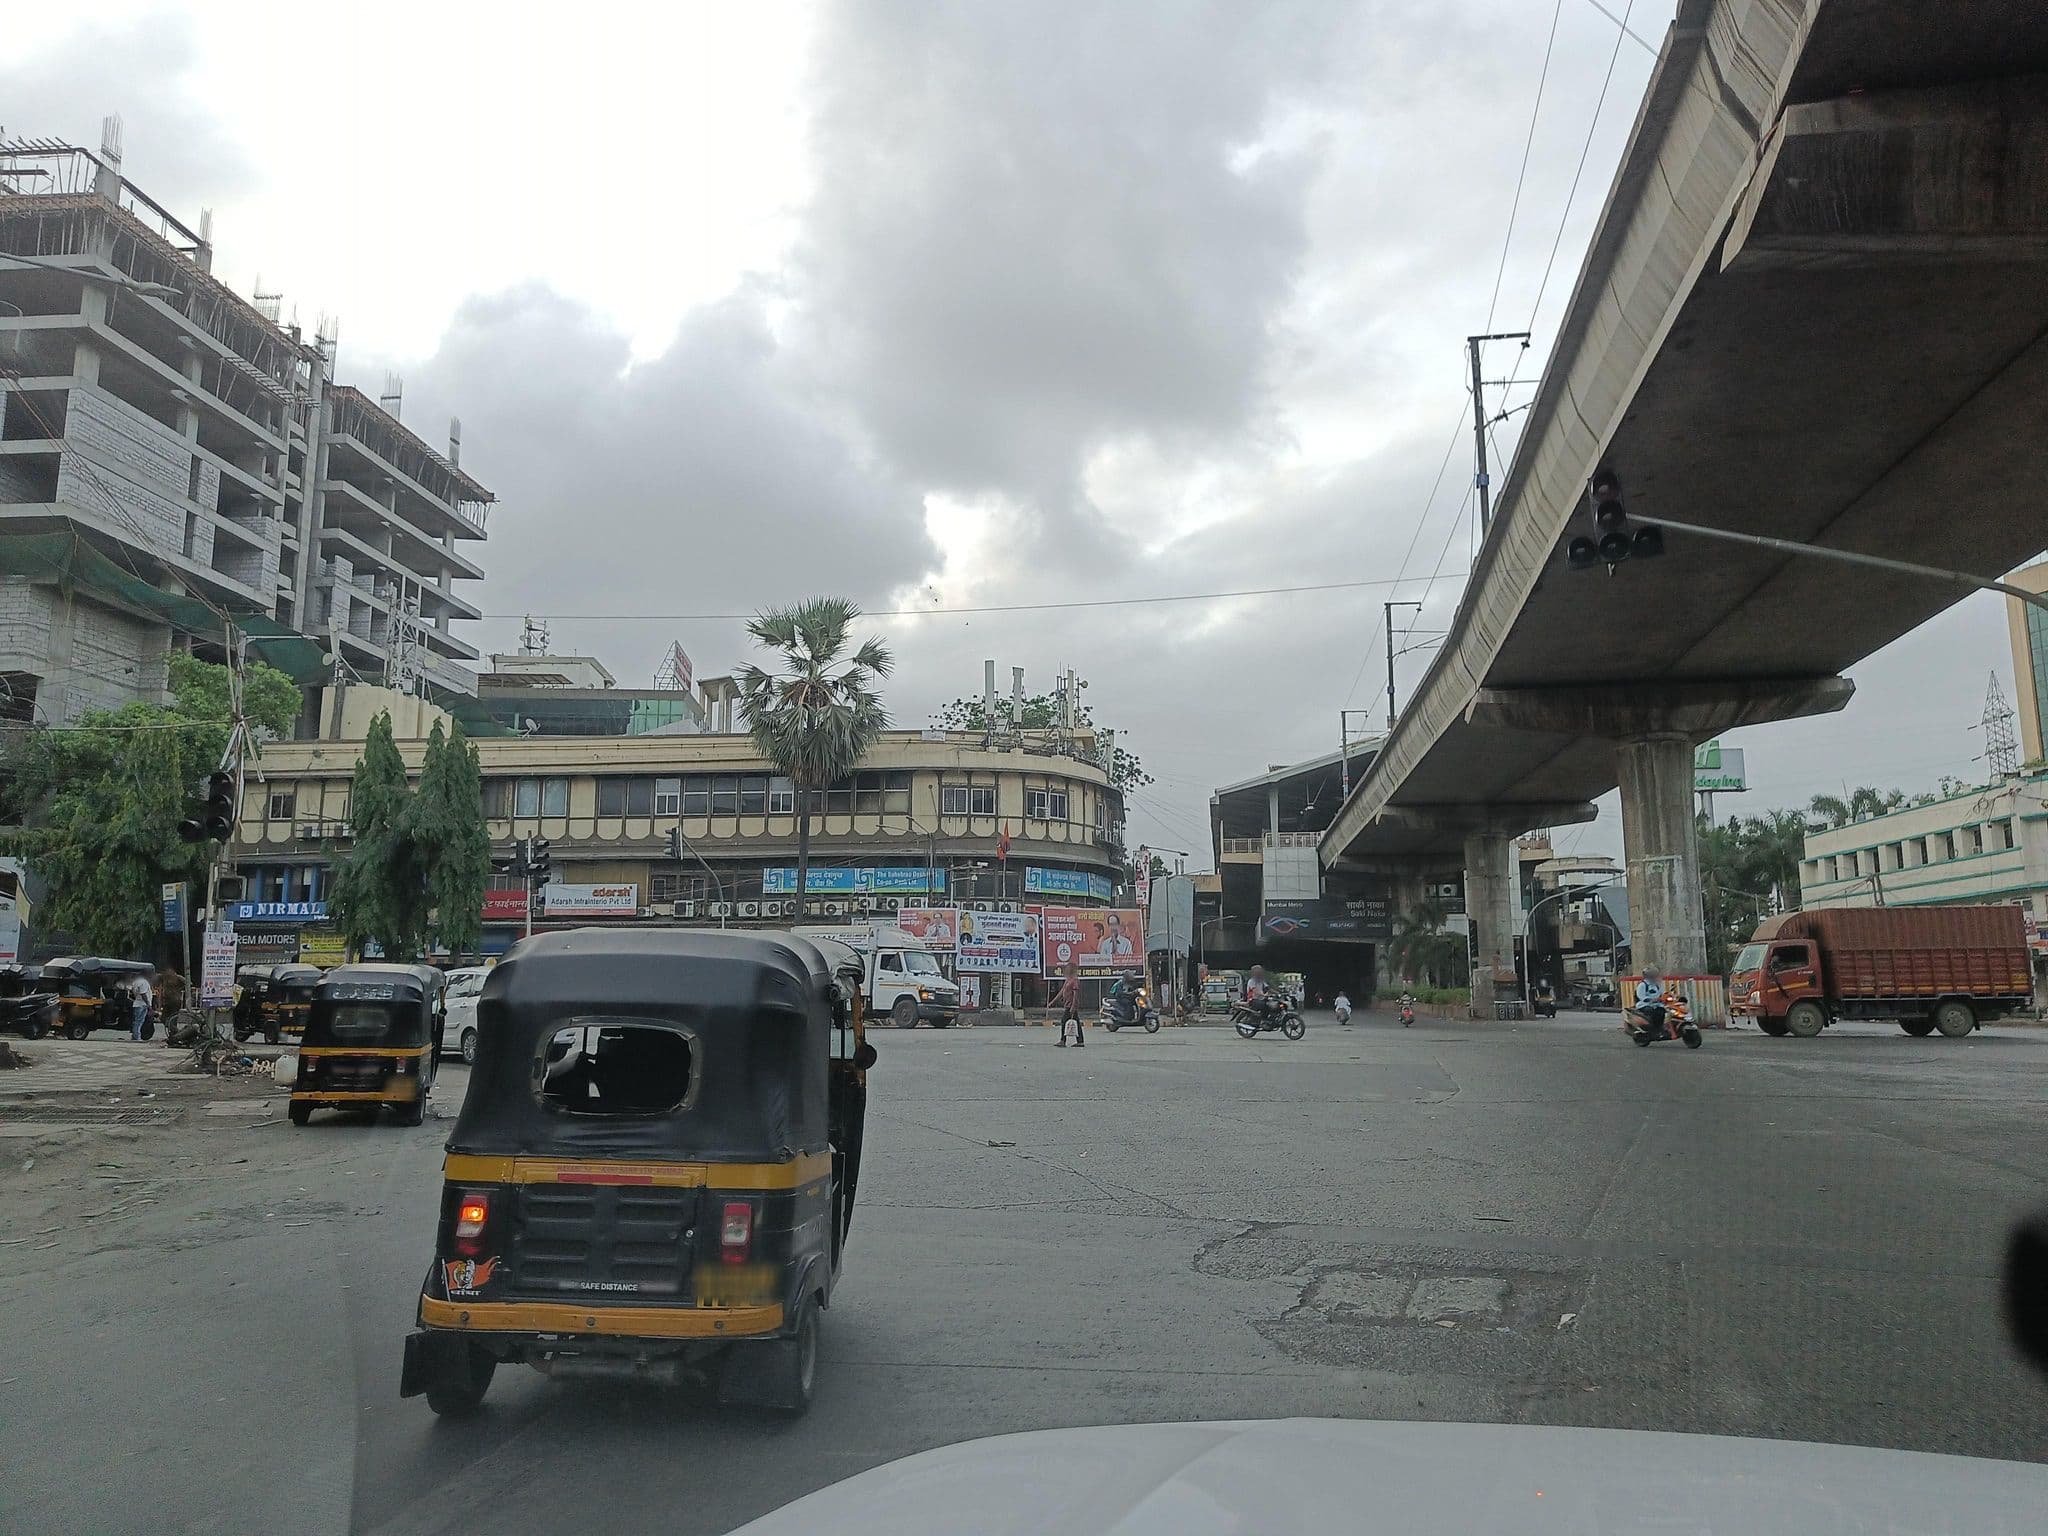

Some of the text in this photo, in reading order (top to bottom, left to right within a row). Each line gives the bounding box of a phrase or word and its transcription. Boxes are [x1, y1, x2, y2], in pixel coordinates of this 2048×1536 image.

[592, 887, 631, 897] adarsh
[257, 902, 320, 915] NIRMAL
[1346, 900, 1365, 909] साकी
[257, 935, 296, 944] MOTORS
[580, 1282, 600, 1290] SAFE
[601, 1283, 638, 1292] DISTANCE
